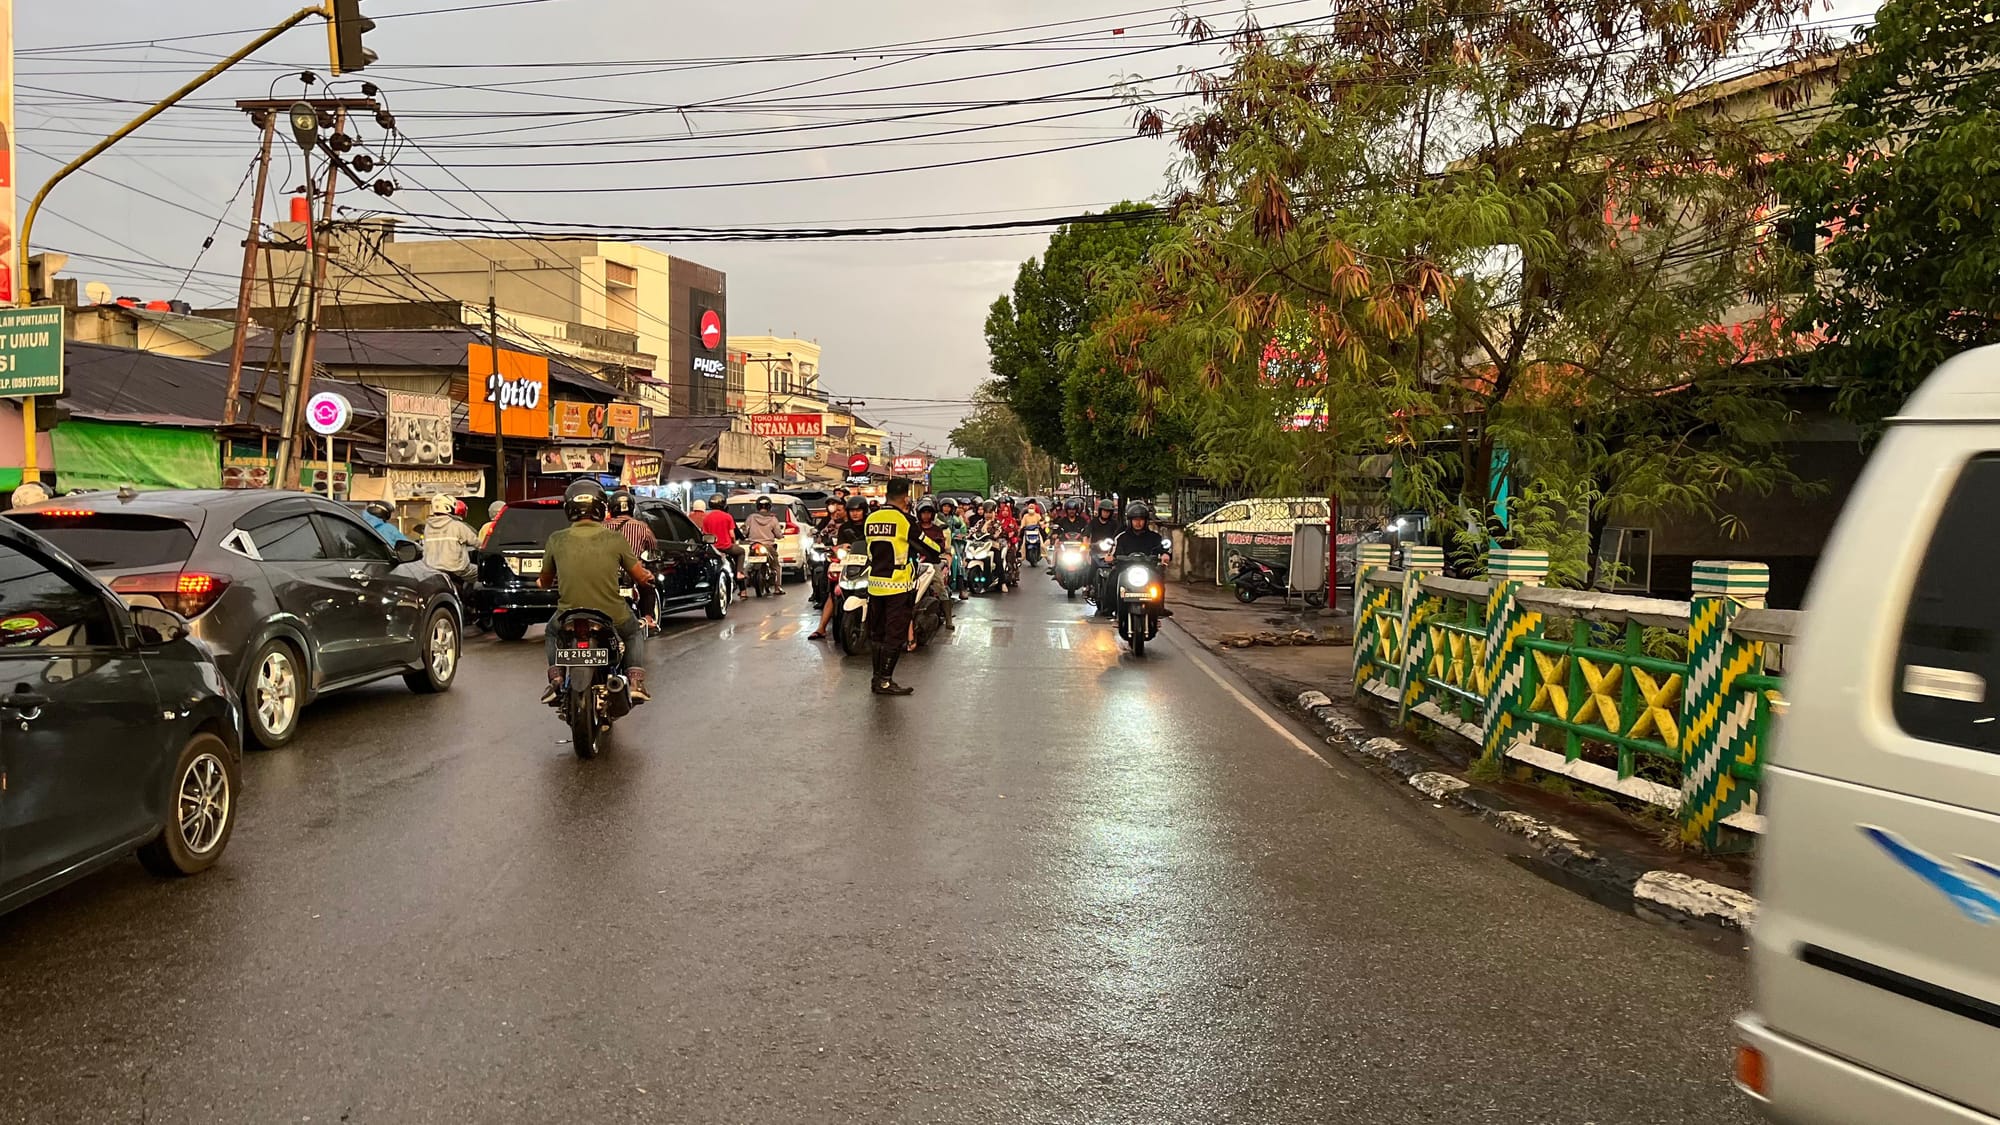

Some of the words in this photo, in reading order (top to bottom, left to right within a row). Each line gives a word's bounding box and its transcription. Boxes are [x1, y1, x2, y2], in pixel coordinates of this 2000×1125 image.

[16, 314, 59, 326] PONTIANAK
[10, 332, 49, 348] UMUM
[753, 422, 795, 435] ISTANA
[796, 422, 820, 435] MAS
[895, 457, 922, 467] APOTEK
[391, 471, 411, 483] OTI
[868, 524, 892, 534] POLISI
[558, 650, 569, 658] KB
[571, 650, 592, 658] 2165
